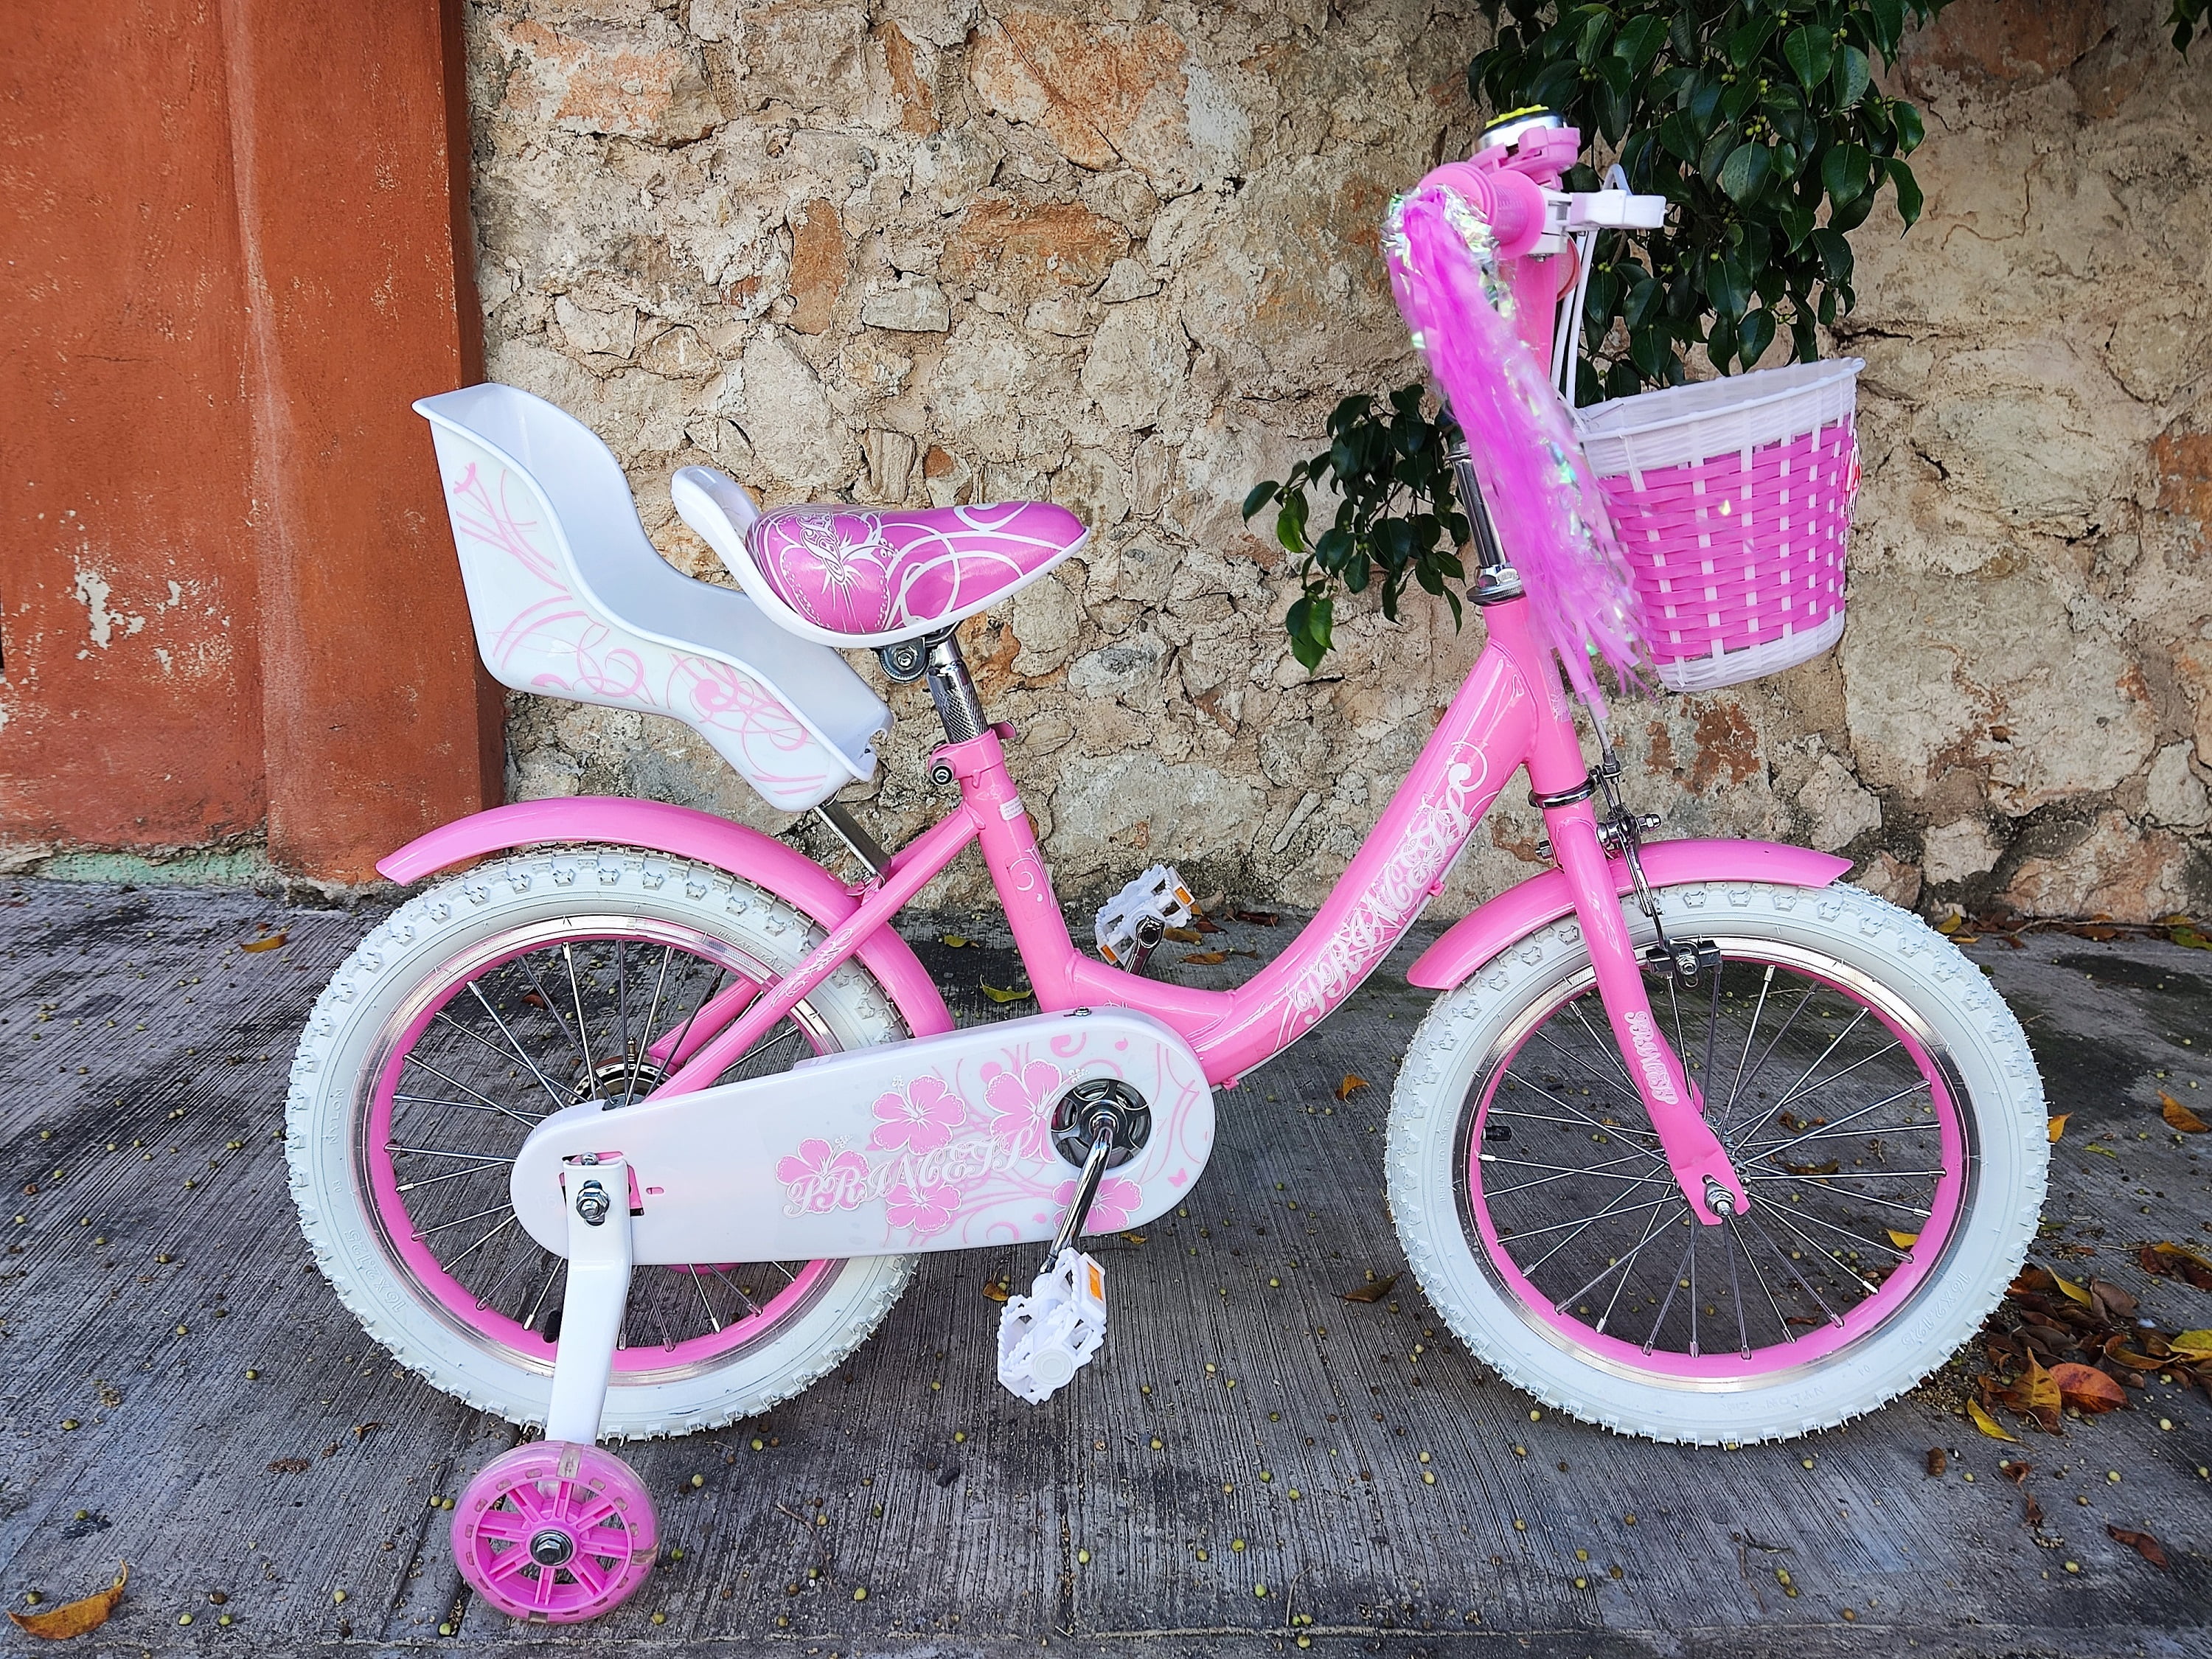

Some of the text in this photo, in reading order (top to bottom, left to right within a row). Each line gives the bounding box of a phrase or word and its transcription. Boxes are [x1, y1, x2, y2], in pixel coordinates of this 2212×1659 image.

[716, 929, 757, 954] INFLATE
[759, 950, 773, 964] TO
[328, 1088, 346, 1145] NYLON
[784, 1127, 1035, 1217] PRINCESS
